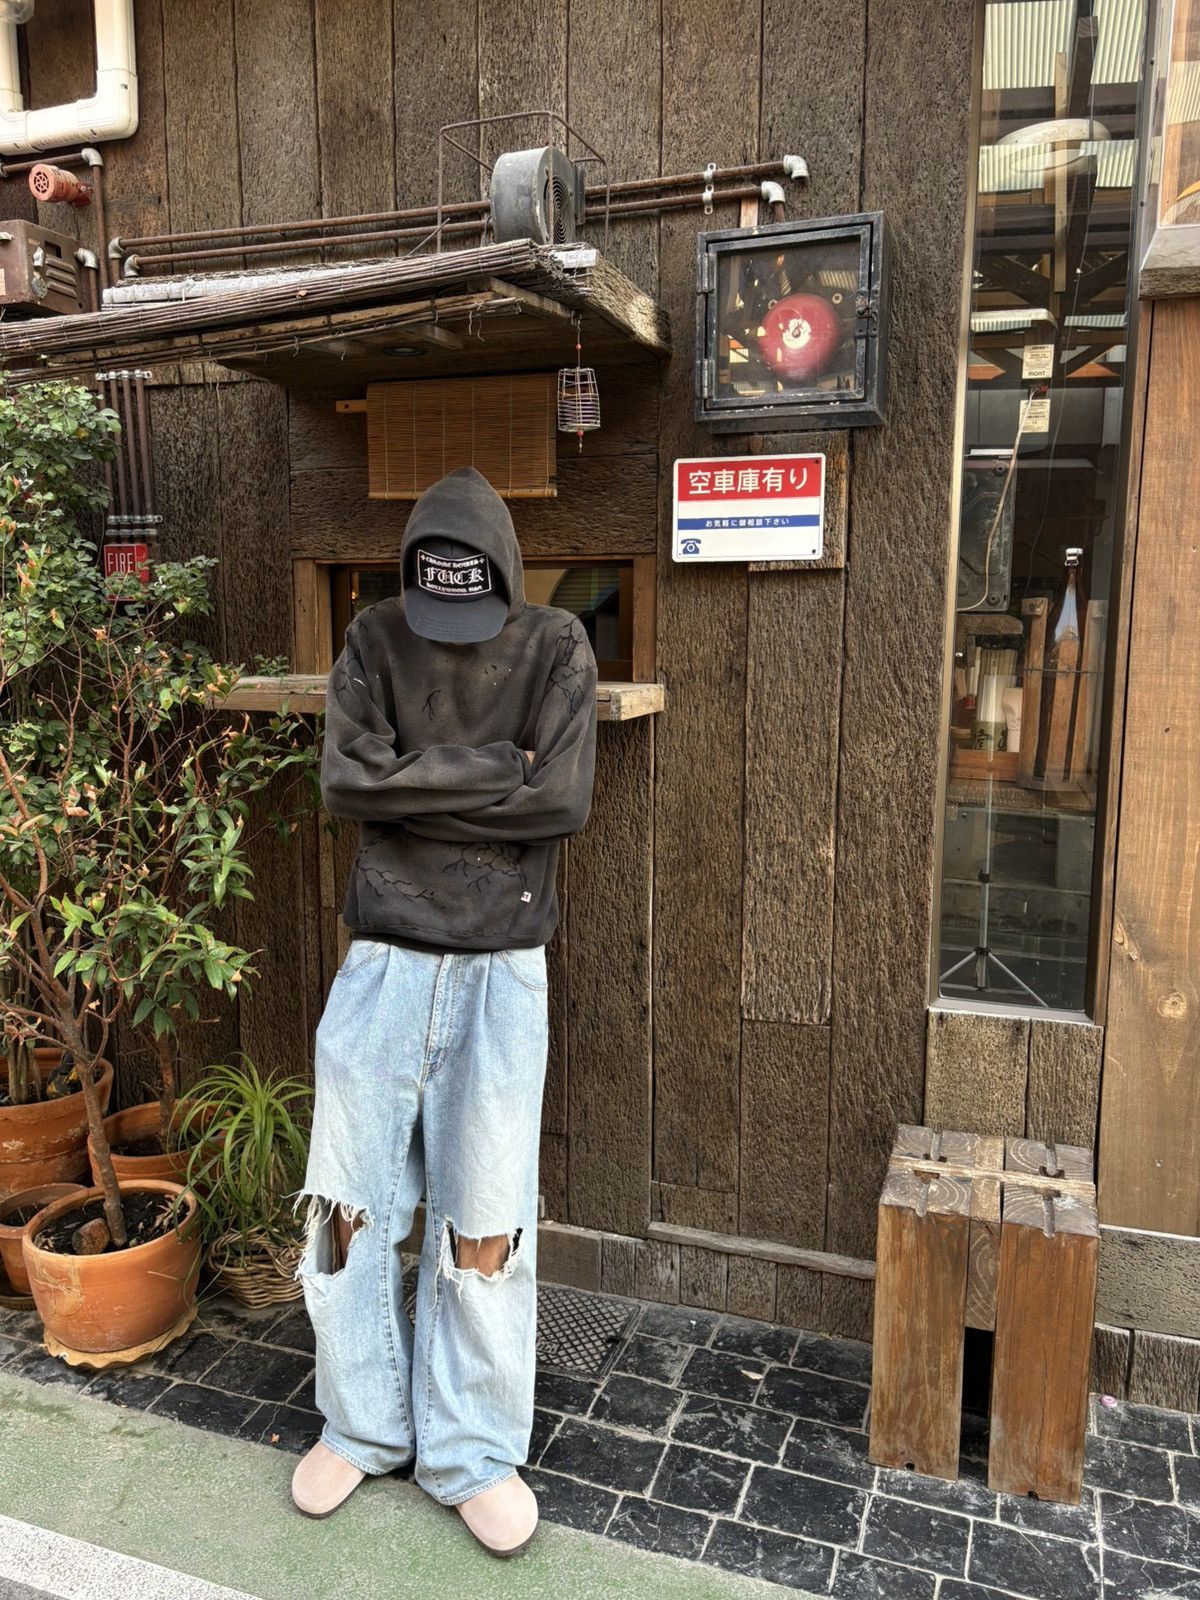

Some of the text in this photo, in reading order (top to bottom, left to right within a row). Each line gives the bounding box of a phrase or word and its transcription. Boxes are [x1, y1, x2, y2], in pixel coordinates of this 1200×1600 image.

[689, 467, 808, 495] 空車庫有り
[107, 552, 134, 573] FIRE
[423, 566, 485, 585] FUCK
